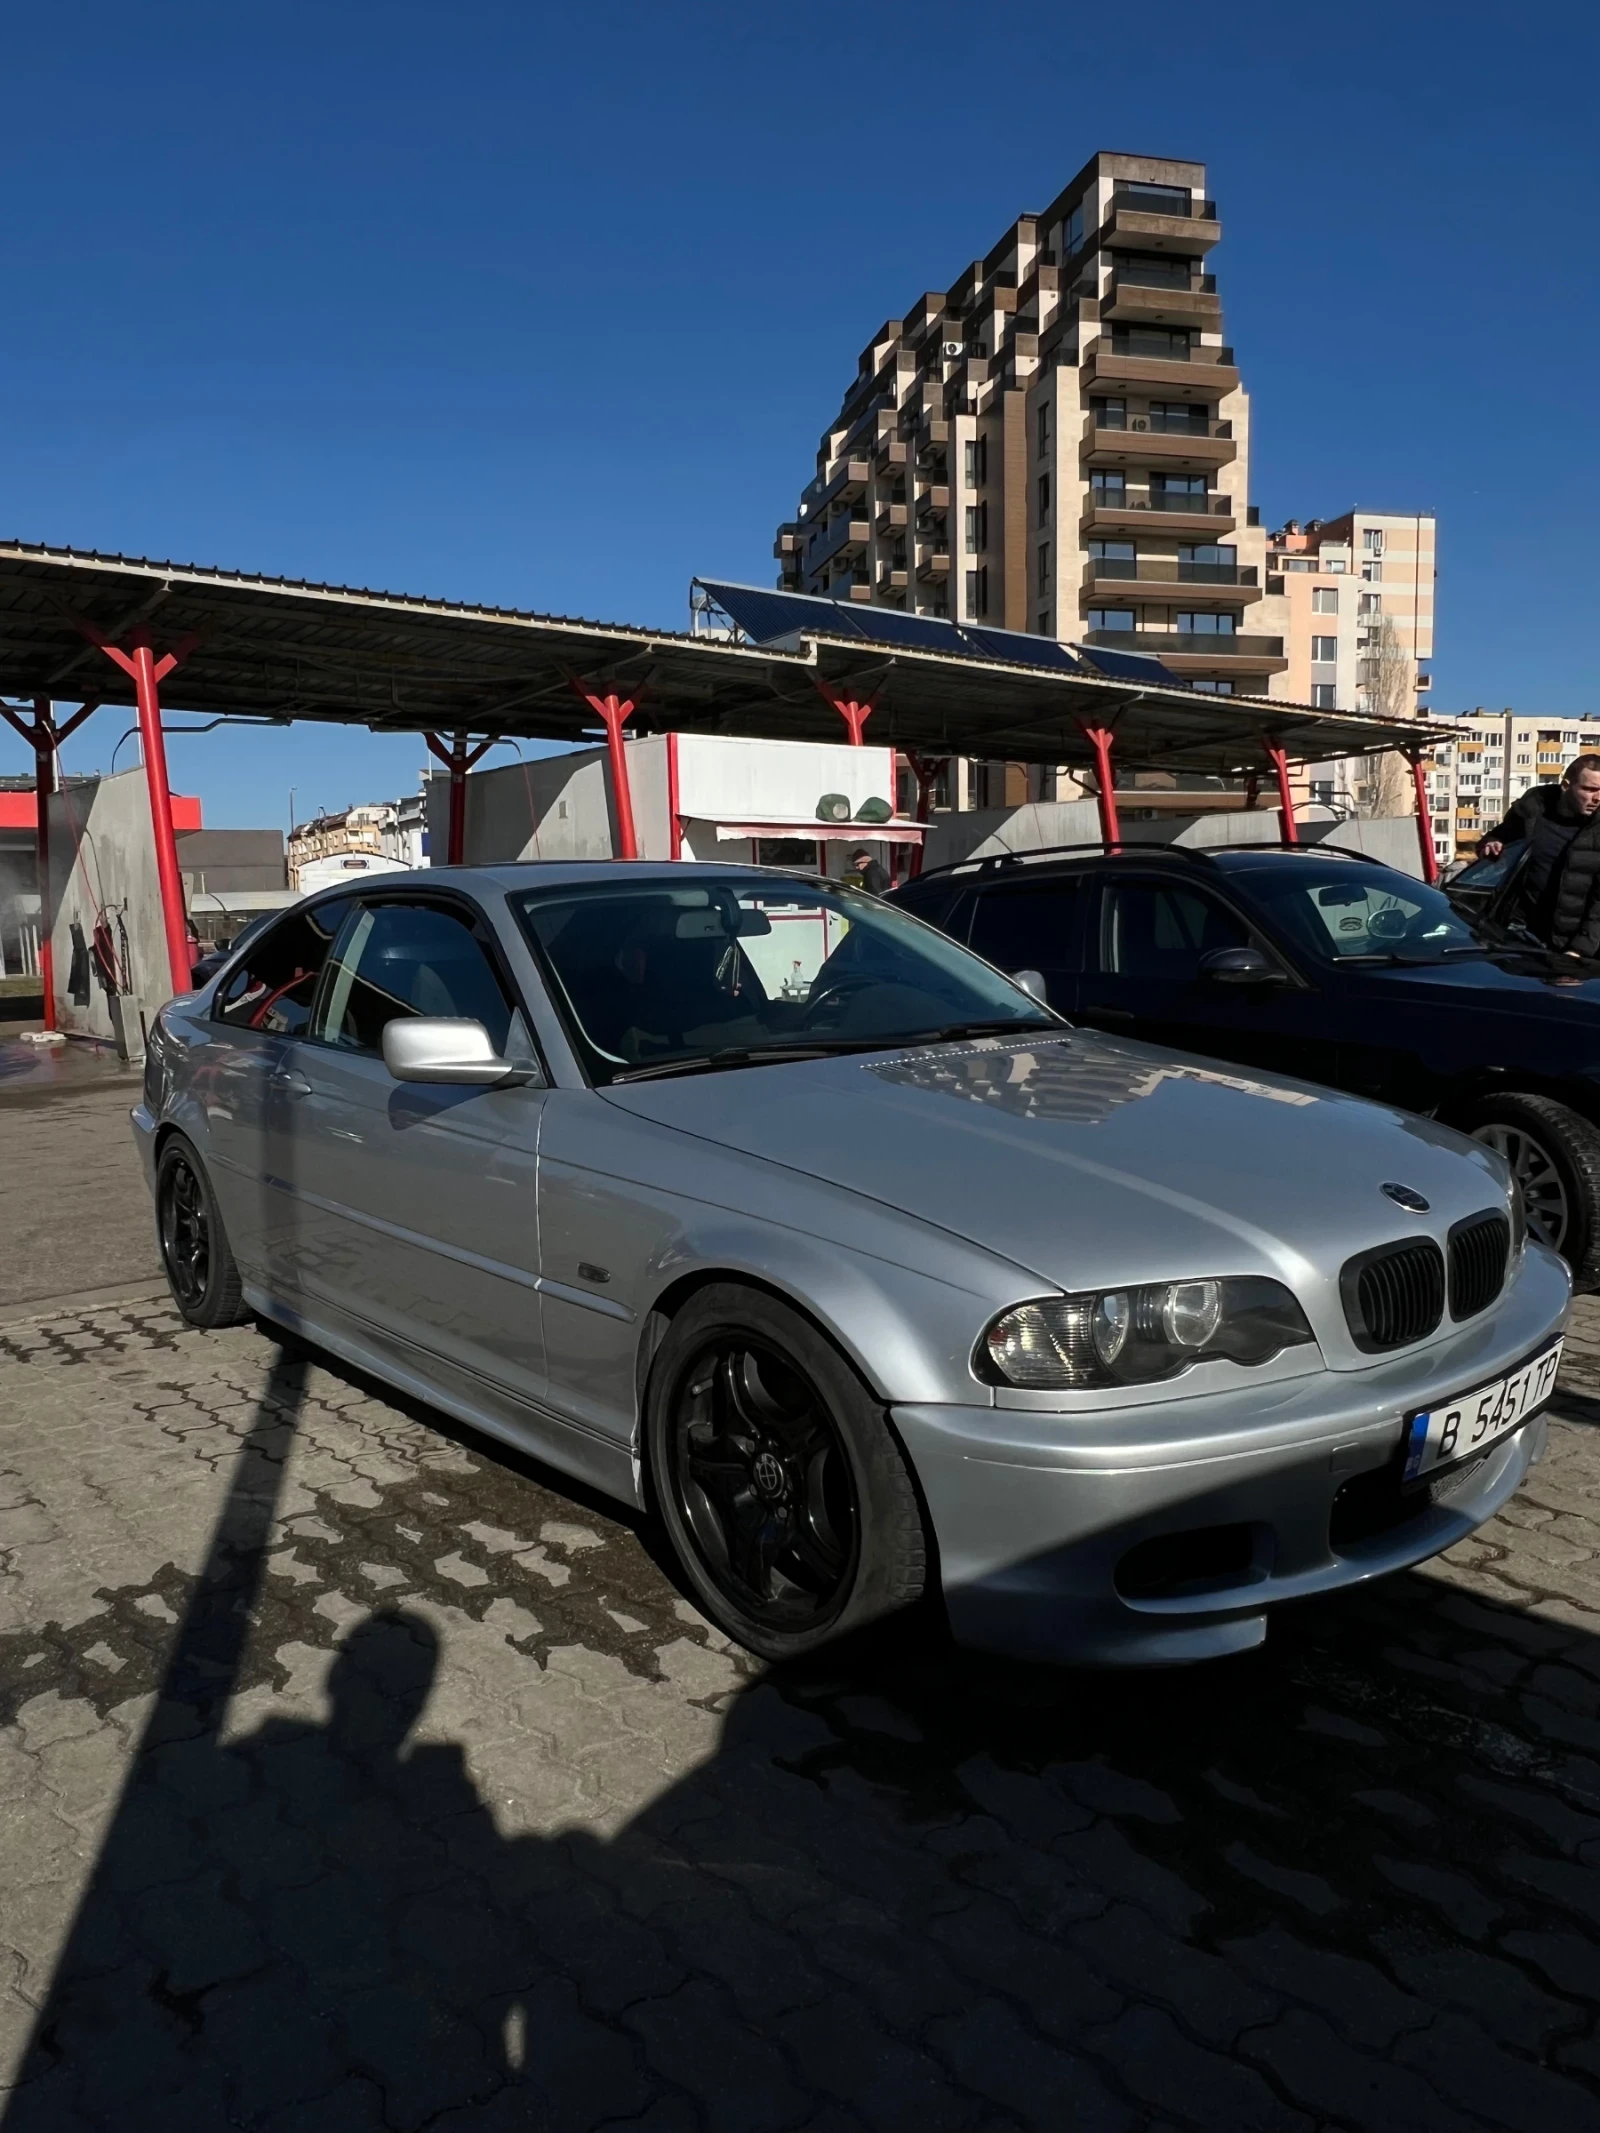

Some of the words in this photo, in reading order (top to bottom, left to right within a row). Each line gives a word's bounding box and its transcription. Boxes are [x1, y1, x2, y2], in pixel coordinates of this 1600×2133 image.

[1436, 1411, 1461, 1460] B
[1471, 1371, 1531, 1443] 5451
[1533, 1351, 1558, 1402] TP
